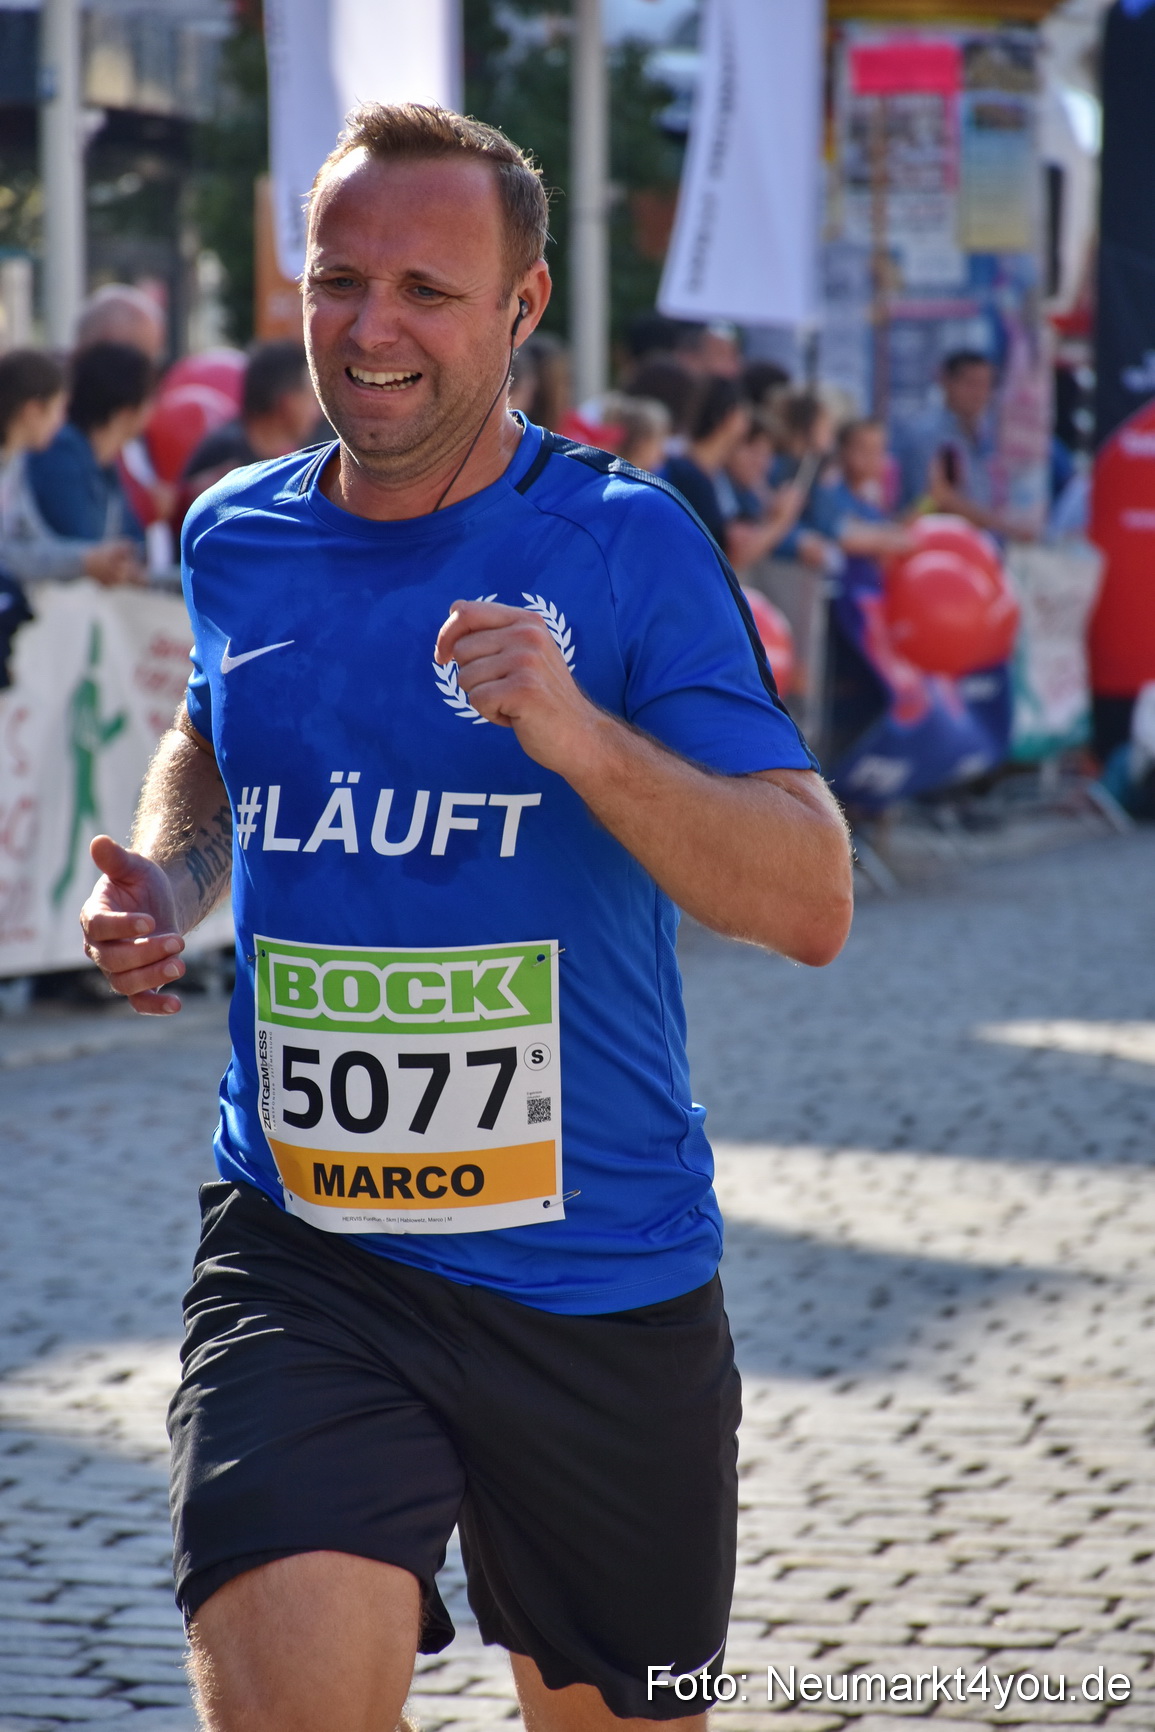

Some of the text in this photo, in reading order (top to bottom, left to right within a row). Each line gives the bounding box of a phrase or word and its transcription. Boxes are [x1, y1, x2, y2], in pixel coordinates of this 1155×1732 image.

[237, 771, 542, 858] #LÄUFT
[270, 953, 528, 1022] BOCK
[282, 1045, 518, 1135] 5077
[531, 1049, 544, 1064] S
[312, 1162, 485, 1200] MARCO
